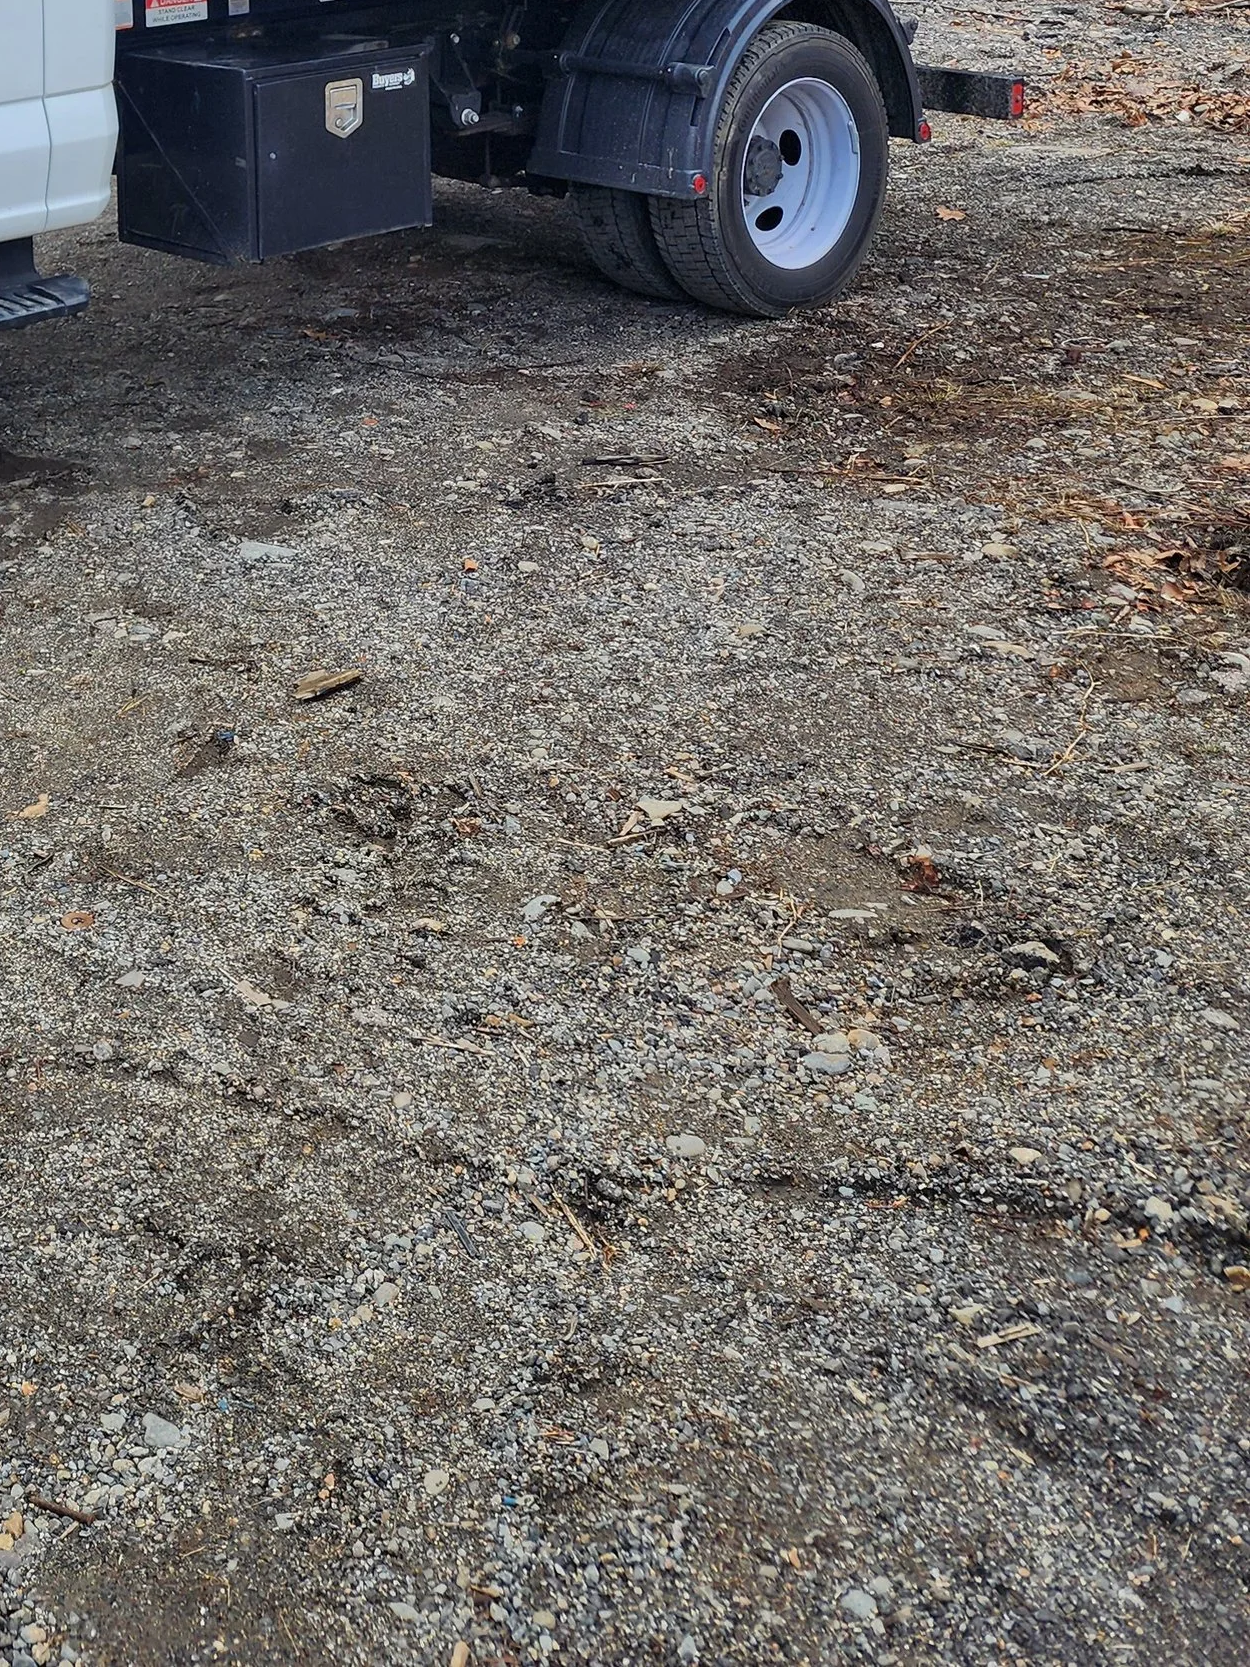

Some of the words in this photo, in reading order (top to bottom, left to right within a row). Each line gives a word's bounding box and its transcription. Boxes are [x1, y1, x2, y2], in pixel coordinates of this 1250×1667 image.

[158, 7, 176, 15] STAND
[177, 5, 195, 13] CLEAR
[152, 15, 169, 23] WHILE
[170, 11, 201, 21] OPERATING
[372, 73, 403, 87] Buyers
